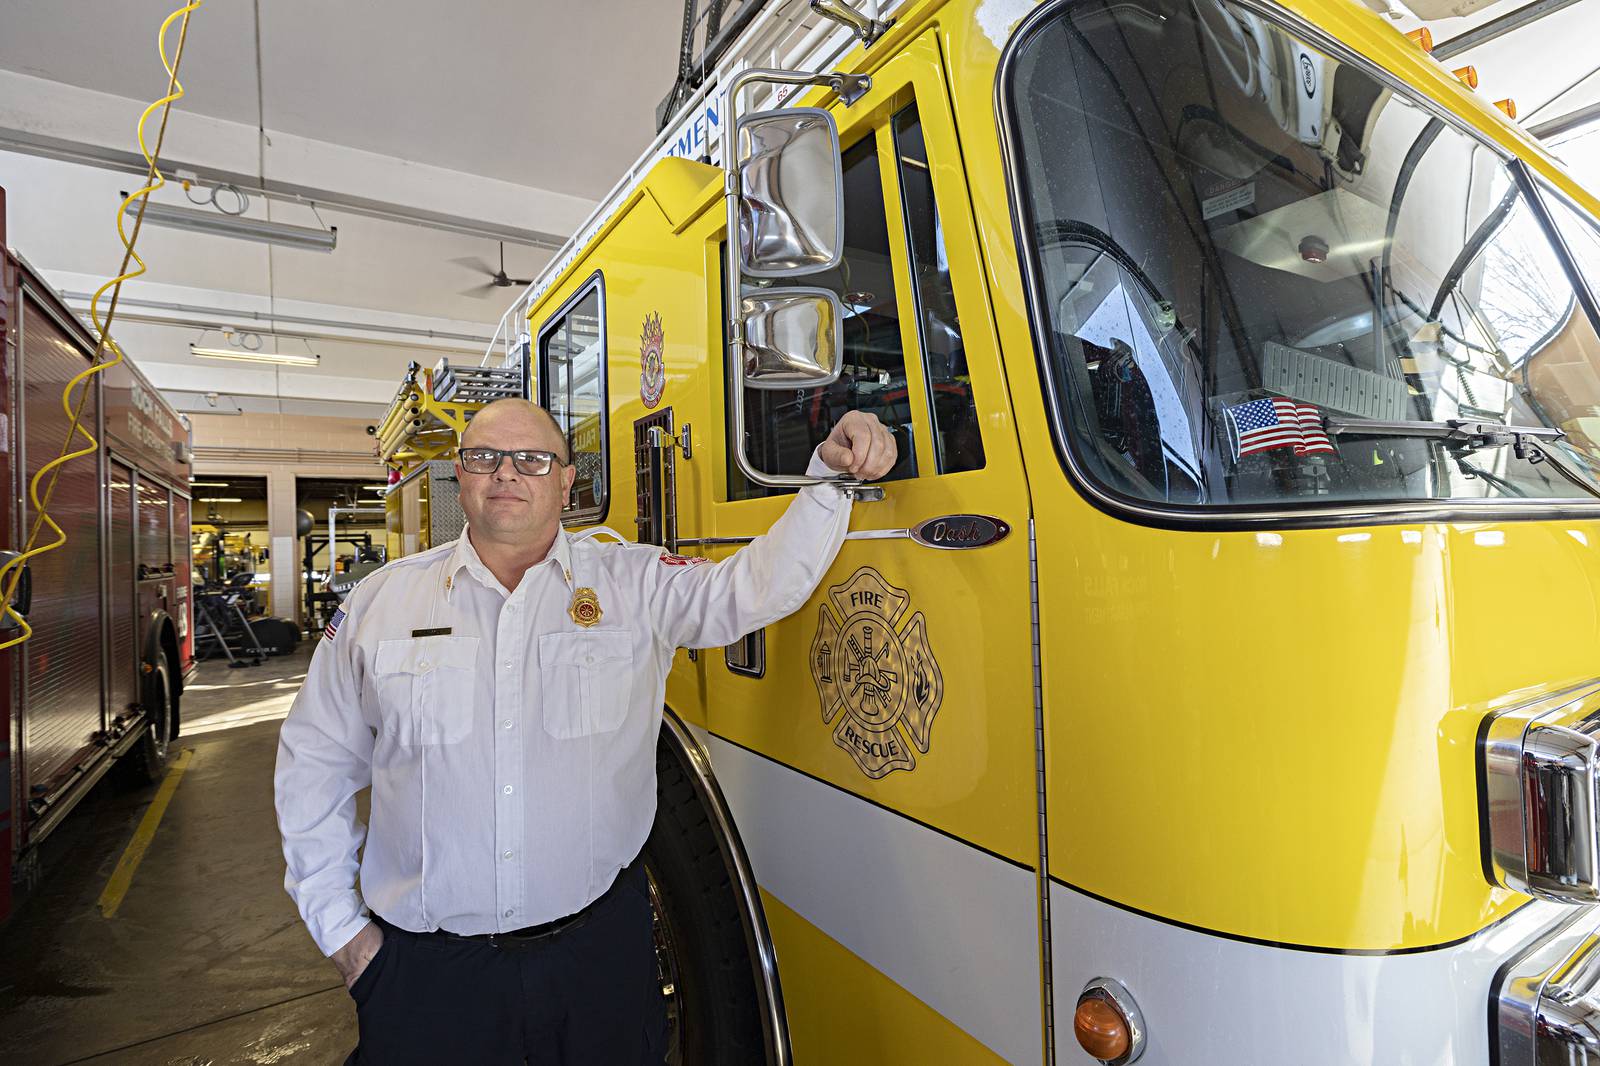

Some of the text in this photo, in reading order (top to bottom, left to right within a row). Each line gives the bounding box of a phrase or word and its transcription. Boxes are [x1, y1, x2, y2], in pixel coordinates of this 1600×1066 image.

[778, 85, 788, 102] 65
[932, 521, 979, 541] Dash
[850, 591, 884, 609] FIRE
[845, 725, 899, 758] RESCUE
